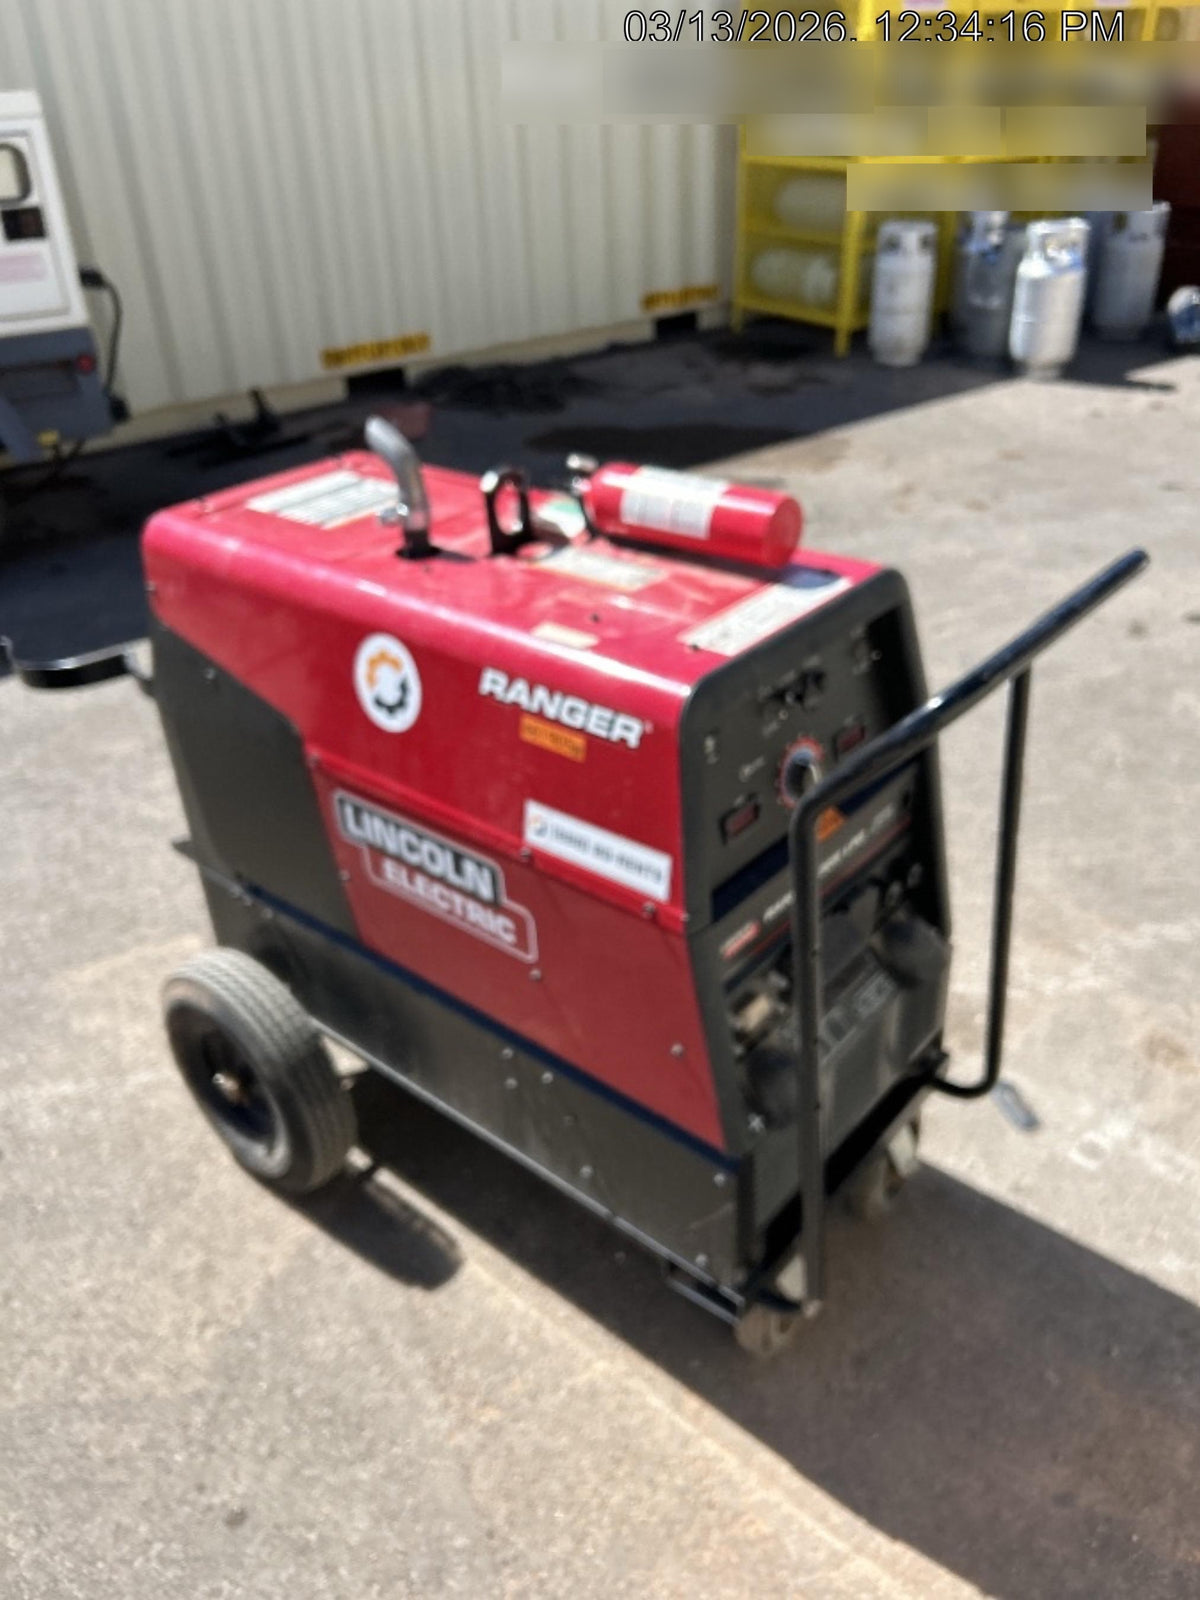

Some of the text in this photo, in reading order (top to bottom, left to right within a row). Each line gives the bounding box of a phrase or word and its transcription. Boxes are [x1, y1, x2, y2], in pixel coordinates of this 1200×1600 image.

[478, 666, 644, 750] RANGER
[342, 800, 496, 903] LINCOLN
[380, 855, 518, 946] ELECTRIC
